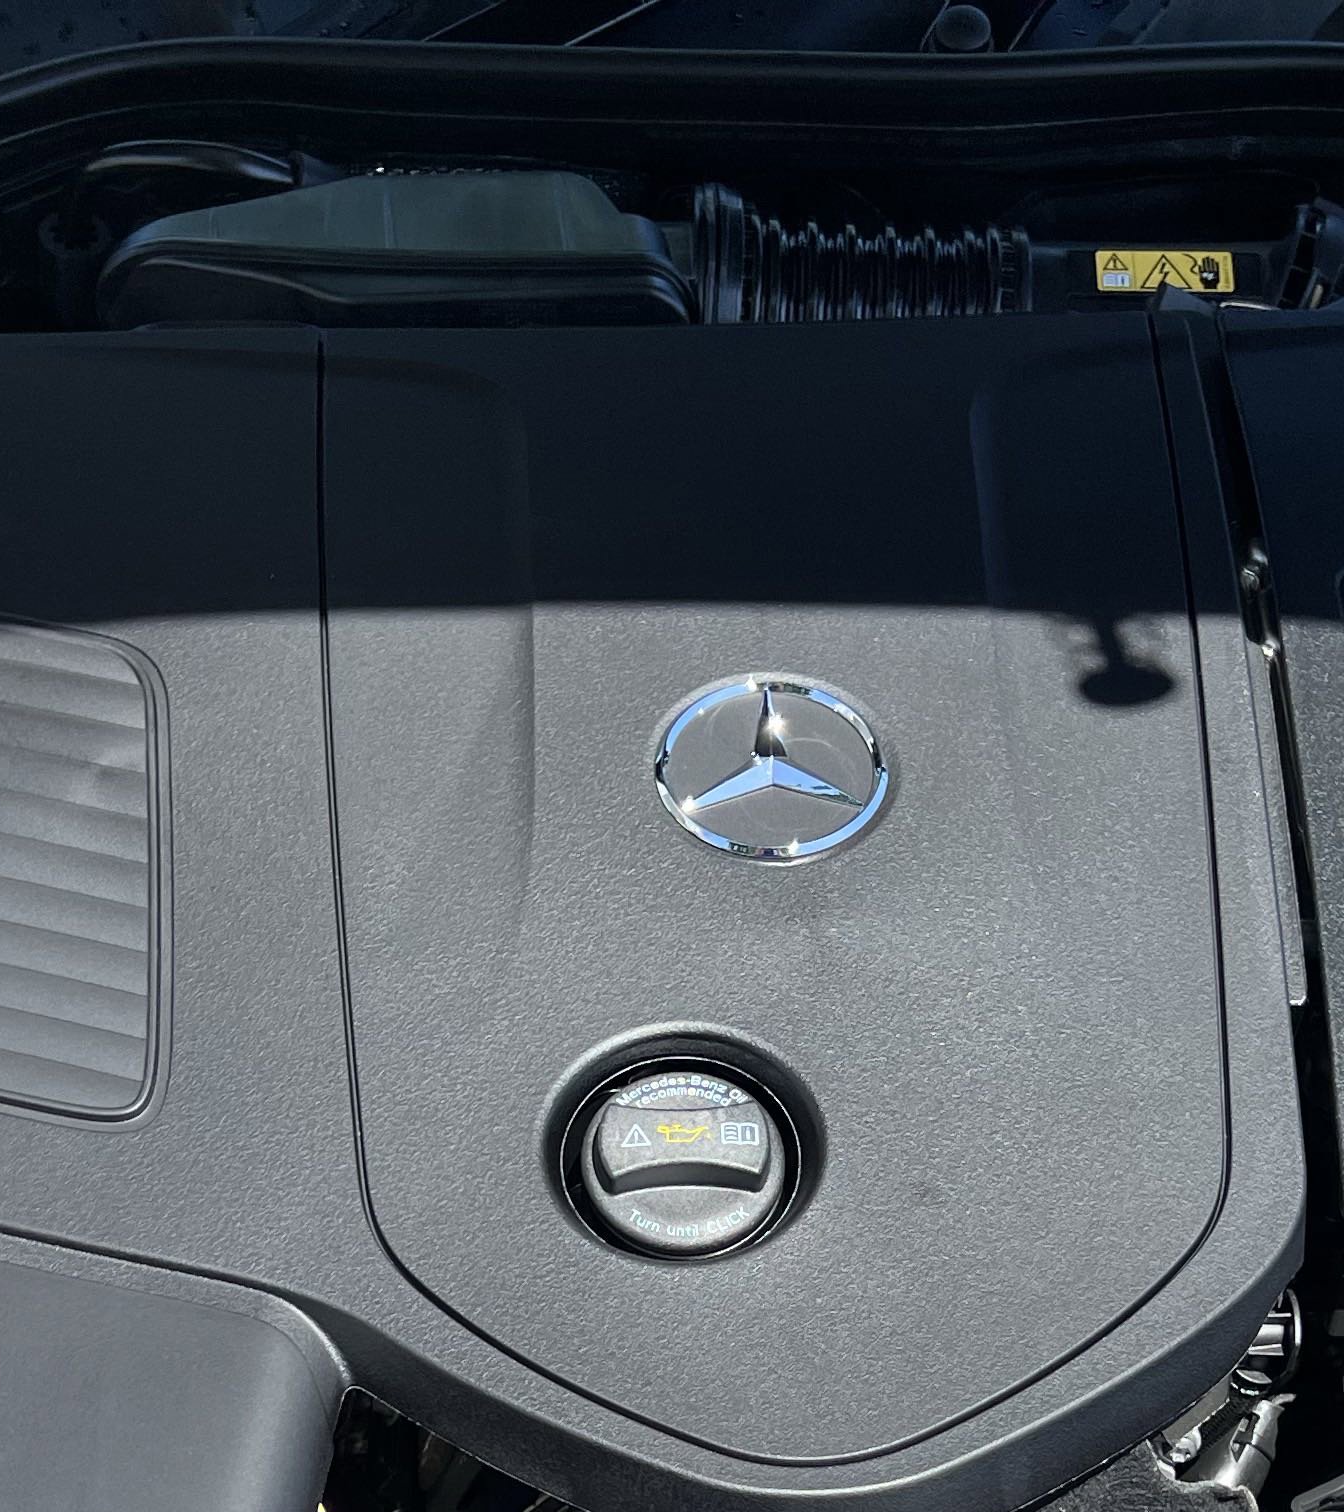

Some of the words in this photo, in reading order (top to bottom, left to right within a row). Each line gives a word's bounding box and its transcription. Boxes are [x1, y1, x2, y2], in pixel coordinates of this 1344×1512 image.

[615, 1075, 728, 1106] Mercedes-Benz
[729, 1088, 749, 1104] Oil
[634, 1086, 732, 1108] recommended
[628, 1208, 661, 1233] Turn
[666, 1223, 699, 1237] until
[706, 1206, 750, 1233] CLICK
